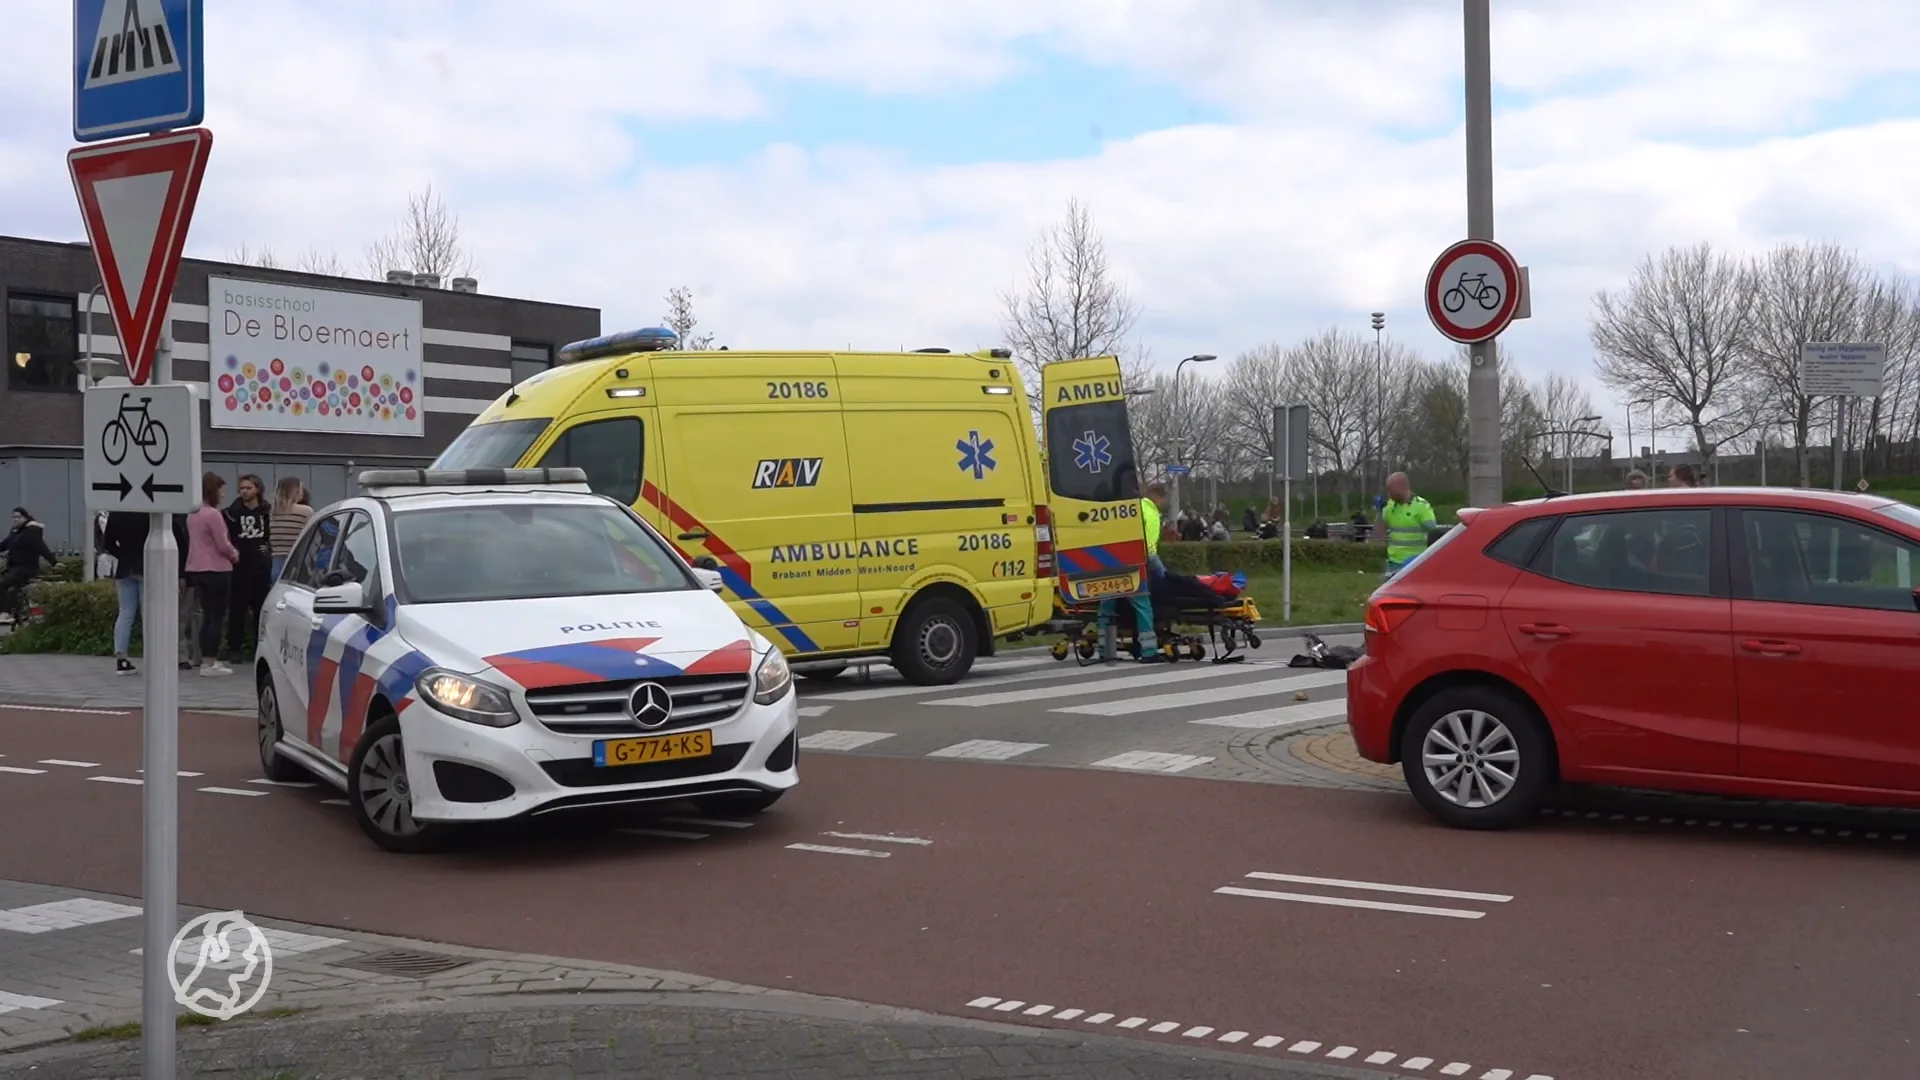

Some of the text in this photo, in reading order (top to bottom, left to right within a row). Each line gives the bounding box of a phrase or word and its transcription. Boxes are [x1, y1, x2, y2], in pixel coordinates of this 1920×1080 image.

[225, 290, 315, 312] basisschool
[224, 309, 410, 351] De Bloemaert
[766, 381, 829, 399] 20186
[1057, 381, 1121, 402] AMBU
[753, 458, 822, 488] RAV
[1090, 503, 1138, 522] 20186
[770, 538, 919, 563] AMBULANCE
[958, 533, 1012, 551] 20186
[772, 569, 812, 580] Brabant
[560, 620, 662, 634] POLITIE
[615, 735, 704, 762] G-774-KS
